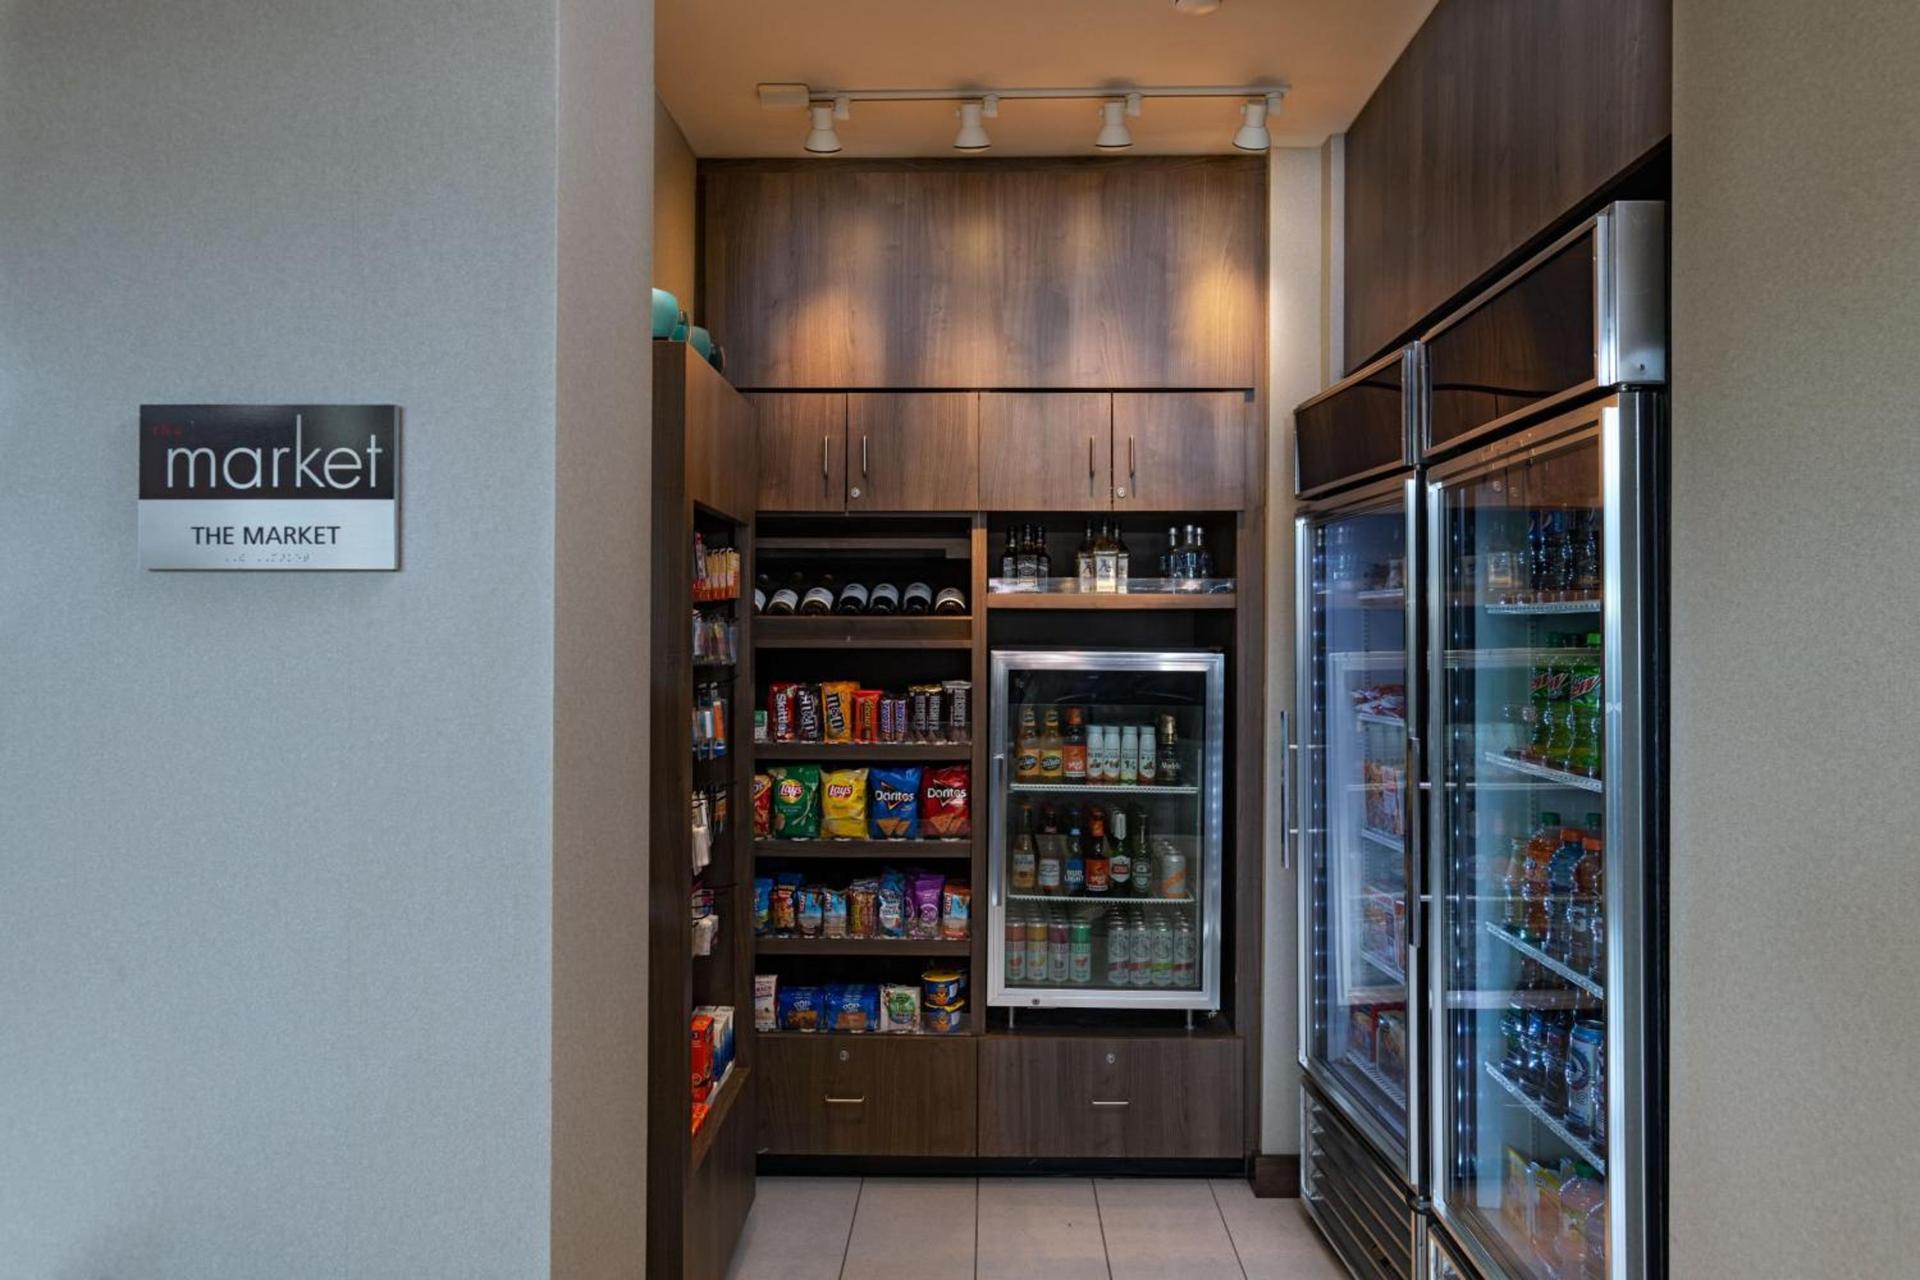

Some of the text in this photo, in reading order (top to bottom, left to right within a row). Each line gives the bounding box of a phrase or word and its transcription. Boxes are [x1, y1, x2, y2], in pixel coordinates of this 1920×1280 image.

[167, 413, 384, 490] market
[190, 525, 341, 545] THE MARKET
[875, 790, 914, 802] Doritos
[927, 786, 967, 799] Doritos
